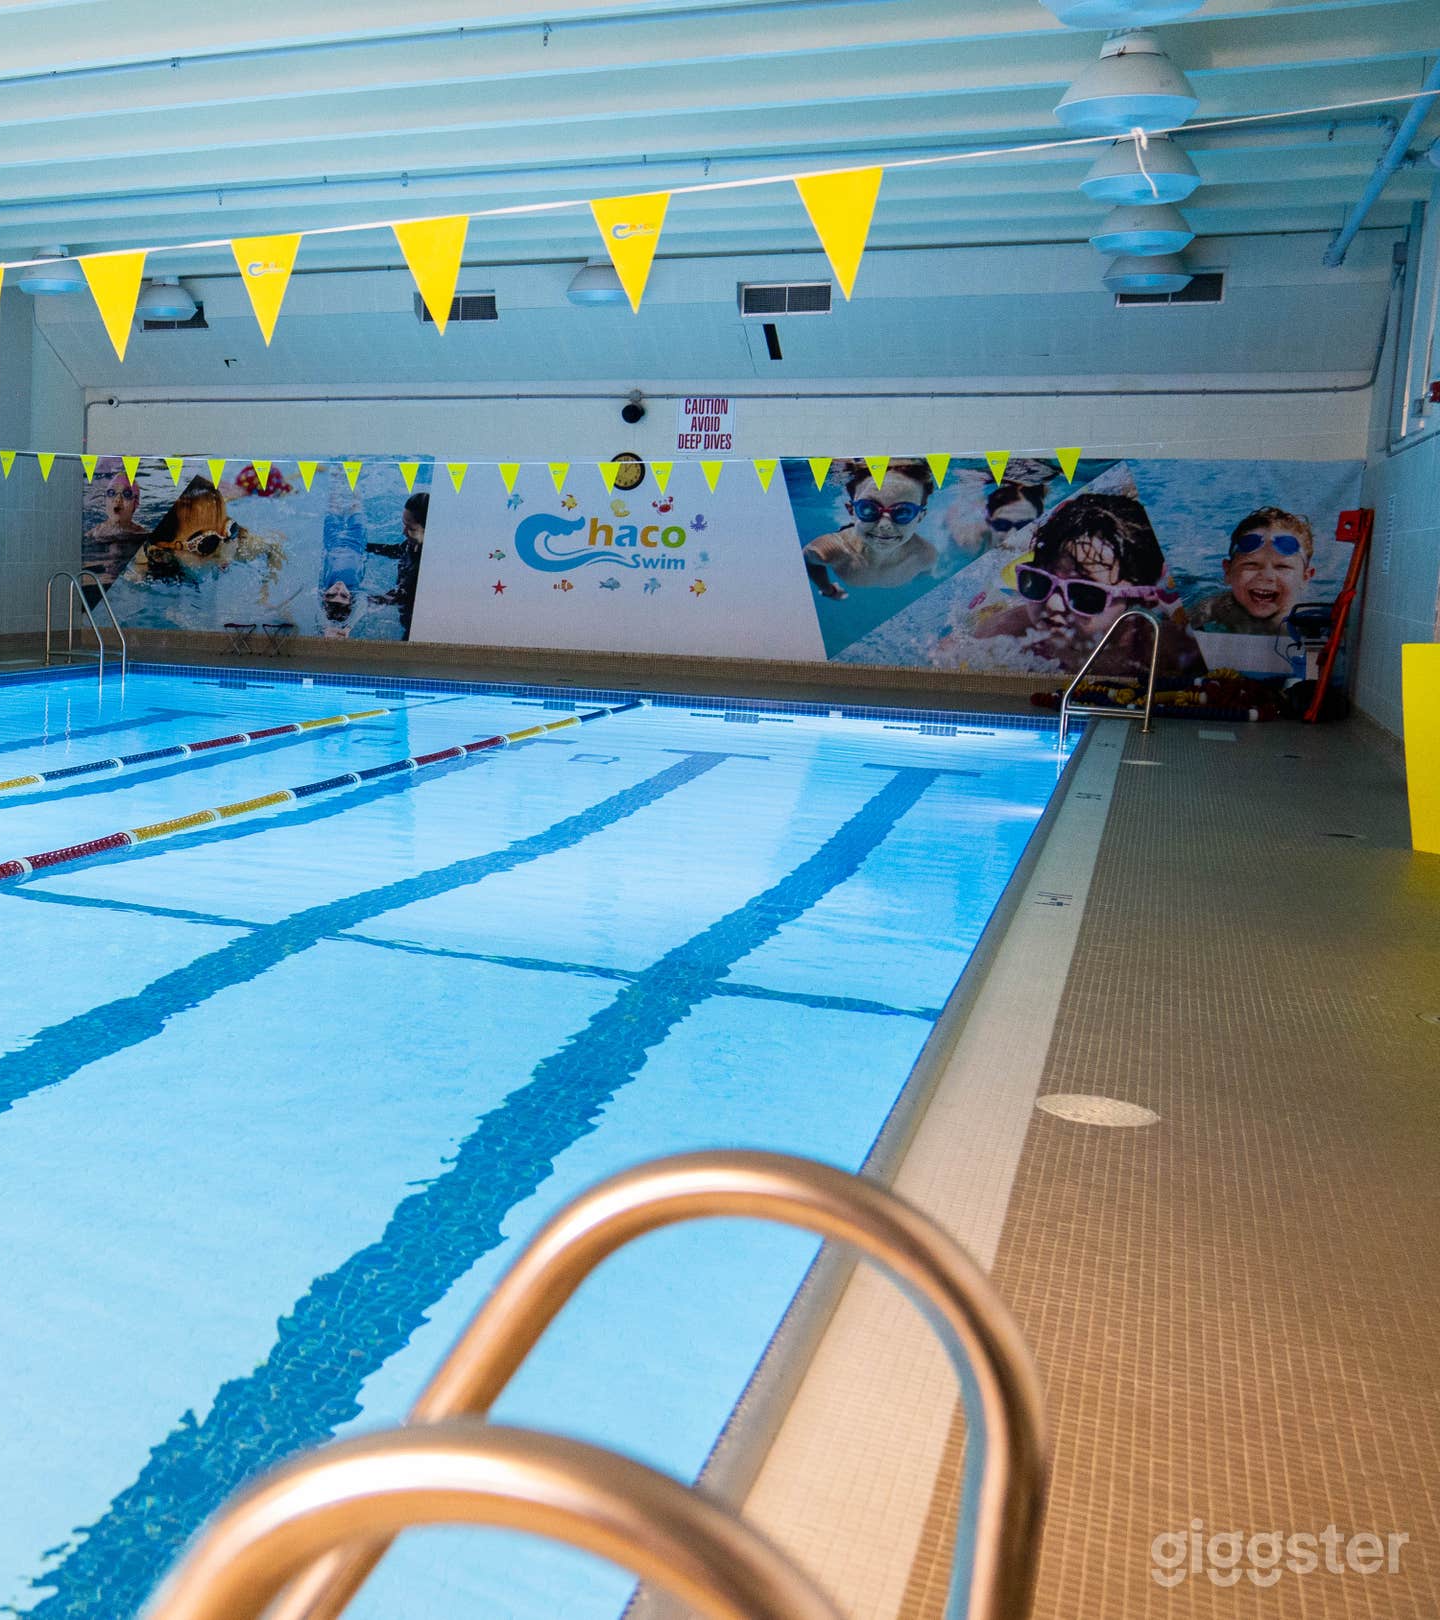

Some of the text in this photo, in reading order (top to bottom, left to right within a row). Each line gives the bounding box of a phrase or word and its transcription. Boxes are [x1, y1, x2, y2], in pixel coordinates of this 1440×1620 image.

[685, 398, 728, 414] CAUTION
[691, 416, 720, 432] AVOID
[678, 433, 732, 450] DEEP DIVES
[630, 554, 686, 570] Swim
